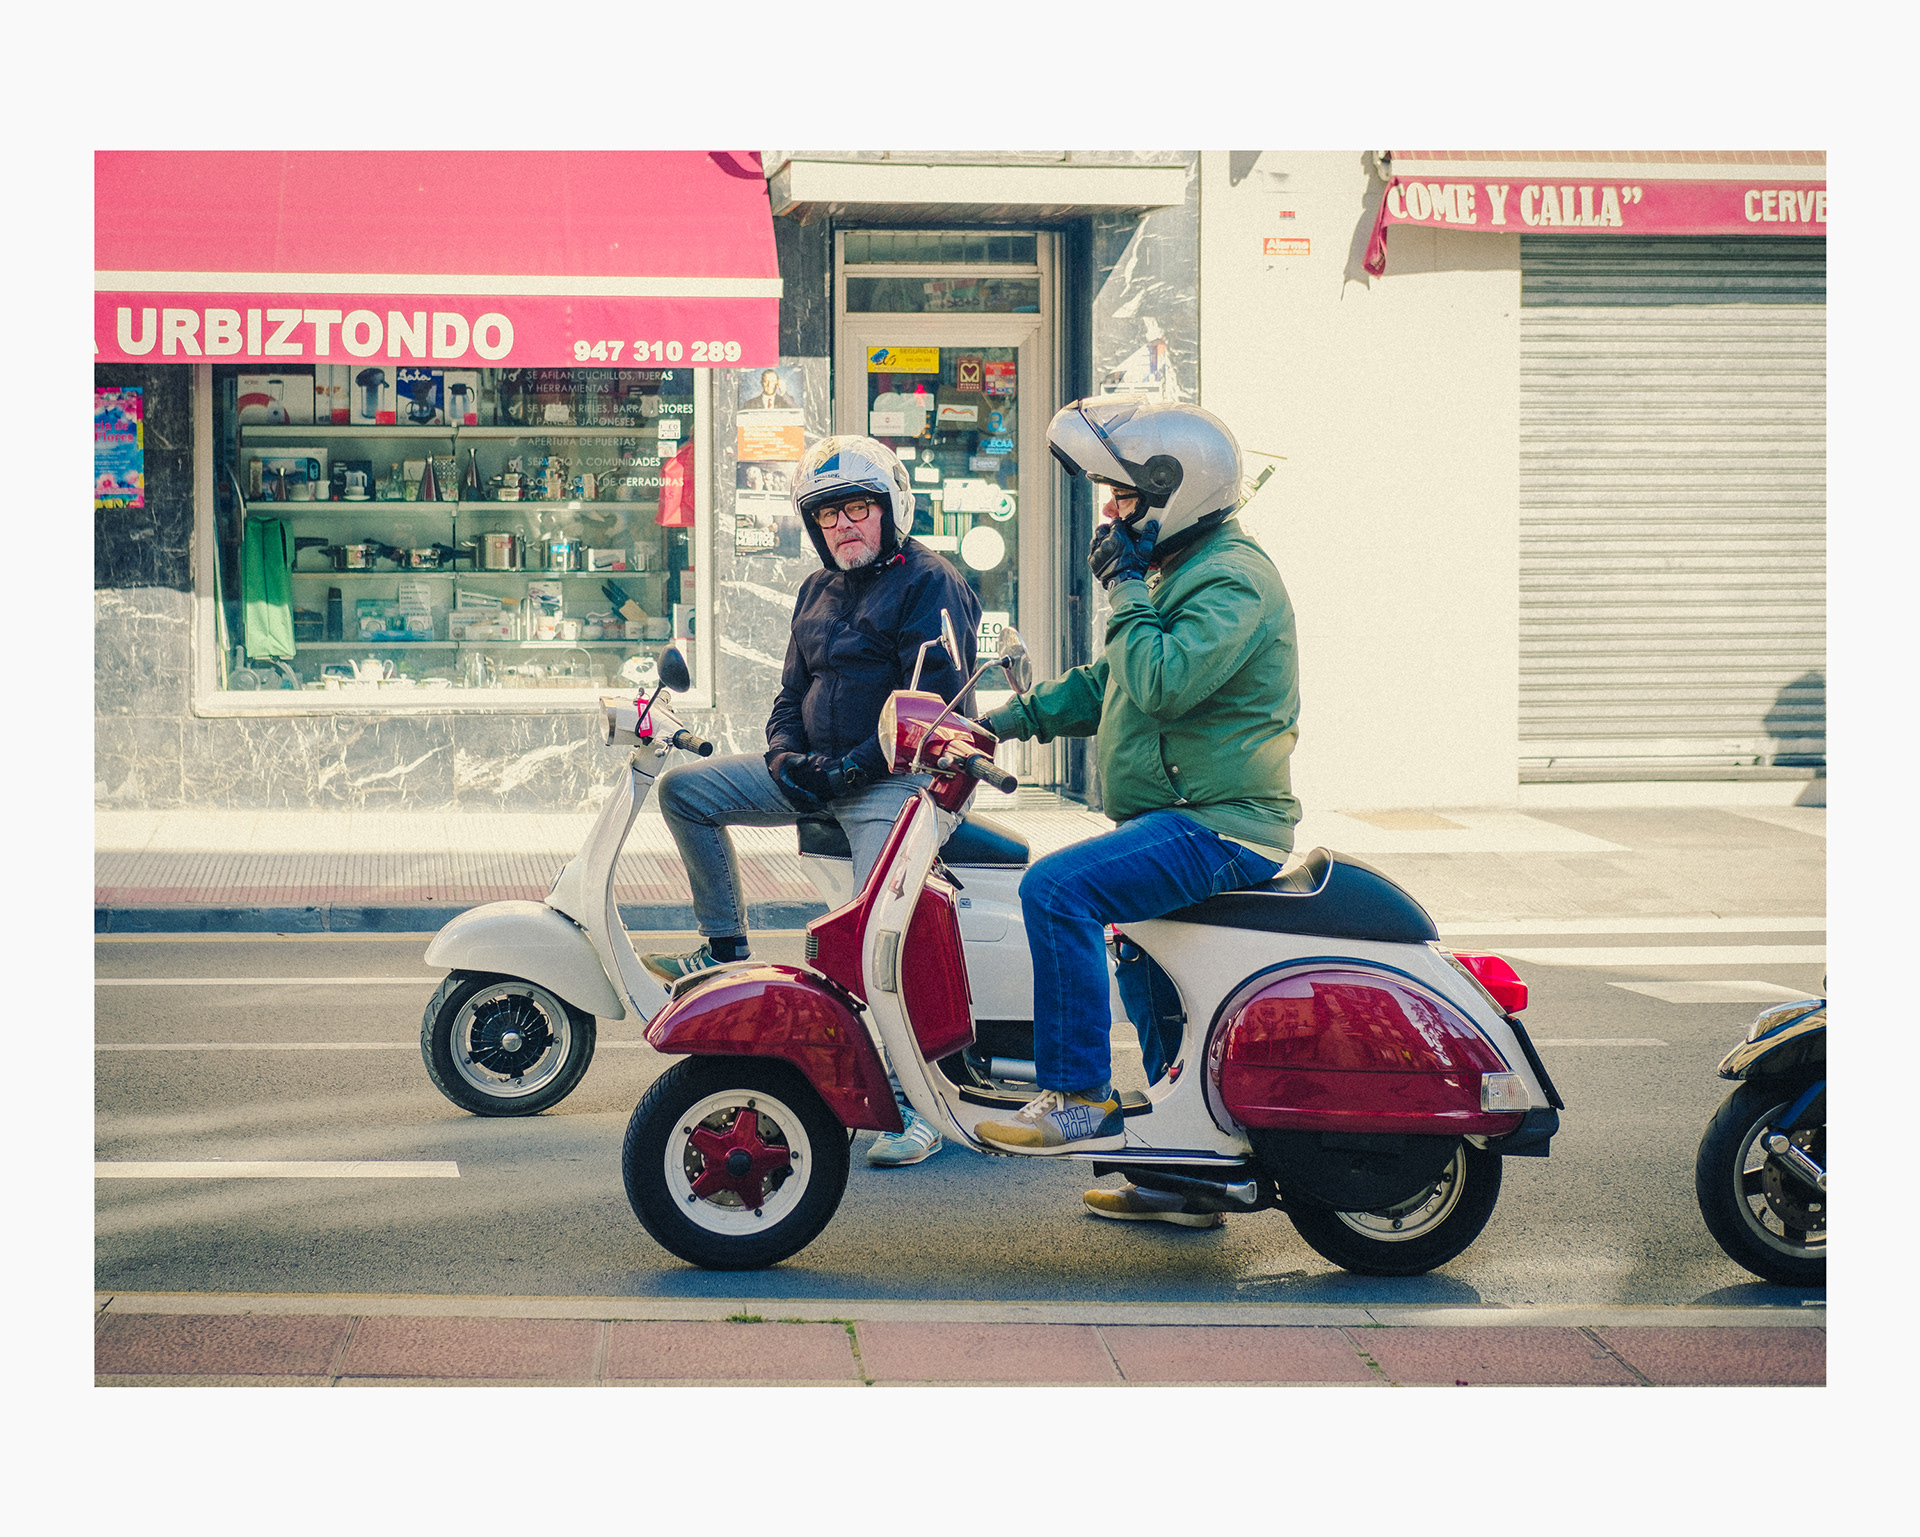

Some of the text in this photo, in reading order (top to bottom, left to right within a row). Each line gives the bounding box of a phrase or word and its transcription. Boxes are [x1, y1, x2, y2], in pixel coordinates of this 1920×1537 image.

[1387, 182, 1477, 224] COME
[1485, 184, 1510, 225] Y
[1744, 189, 1827, 223] CERVE
[1266, 238, 1309, 249] Alarma
[117, 307, 514, 360] URBIZTONDO
[573, 340, 742, 362] 947 310 289
[526, 370, 674, 382] SE AFILAN CUCHILLOS, TIJERAS
[526, 383, 610, 394] Y HERRAMIENTAS
[526, 404, 538, 414] SE
[613, 404, 654, 415] BARRA,
[658, 403, 694, 414] STORES
[114, 420, 129, 431] de
[526, 417, 534, 426] Y
[581, 417, 636, 427] JAPONESES
[94, 432, 134, 442] Flores
[527, 437, 637, 447] APERTURA DE PUERTAS
[527, 457, 661, 467] SERVIO A COMUNIDADES
[602, 478, 616, 487] DE
[618, 477, 684, 487] CERRADURAS
